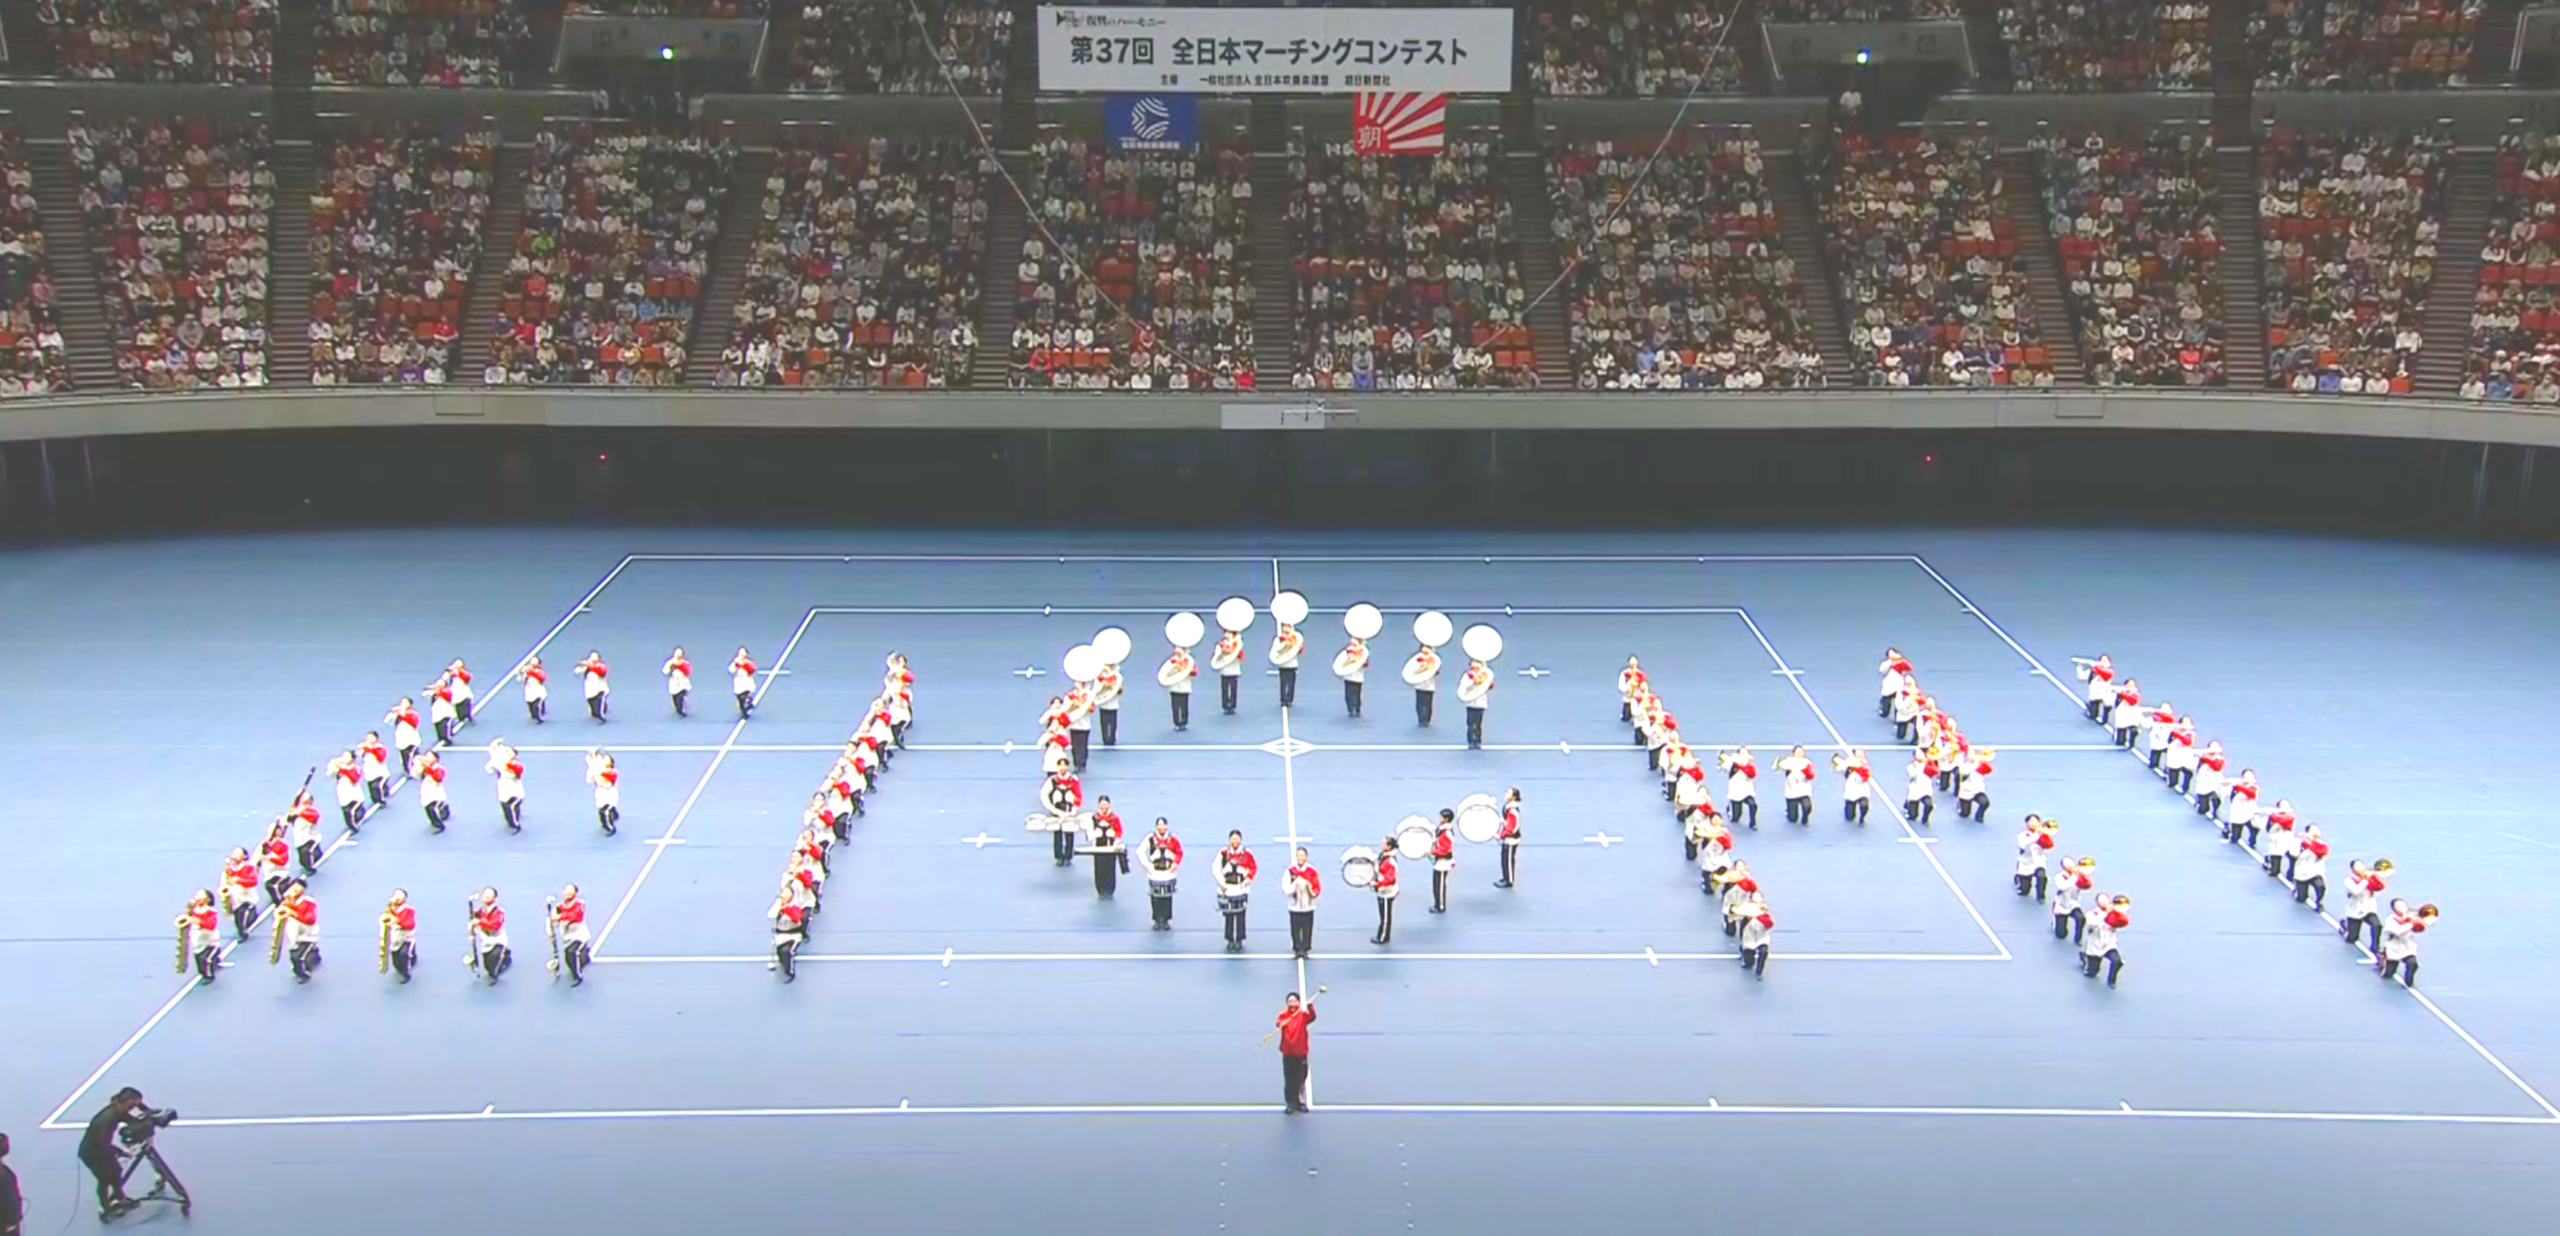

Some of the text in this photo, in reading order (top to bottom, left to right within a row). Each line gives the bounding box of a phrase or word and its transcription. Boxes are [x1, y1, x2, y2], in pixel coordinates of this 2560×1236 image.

[1070, 36, 1468, 66] 第37回 全日本マーチングコンテスト
[1345, 74, 1391, 86] 朝日新聞社
